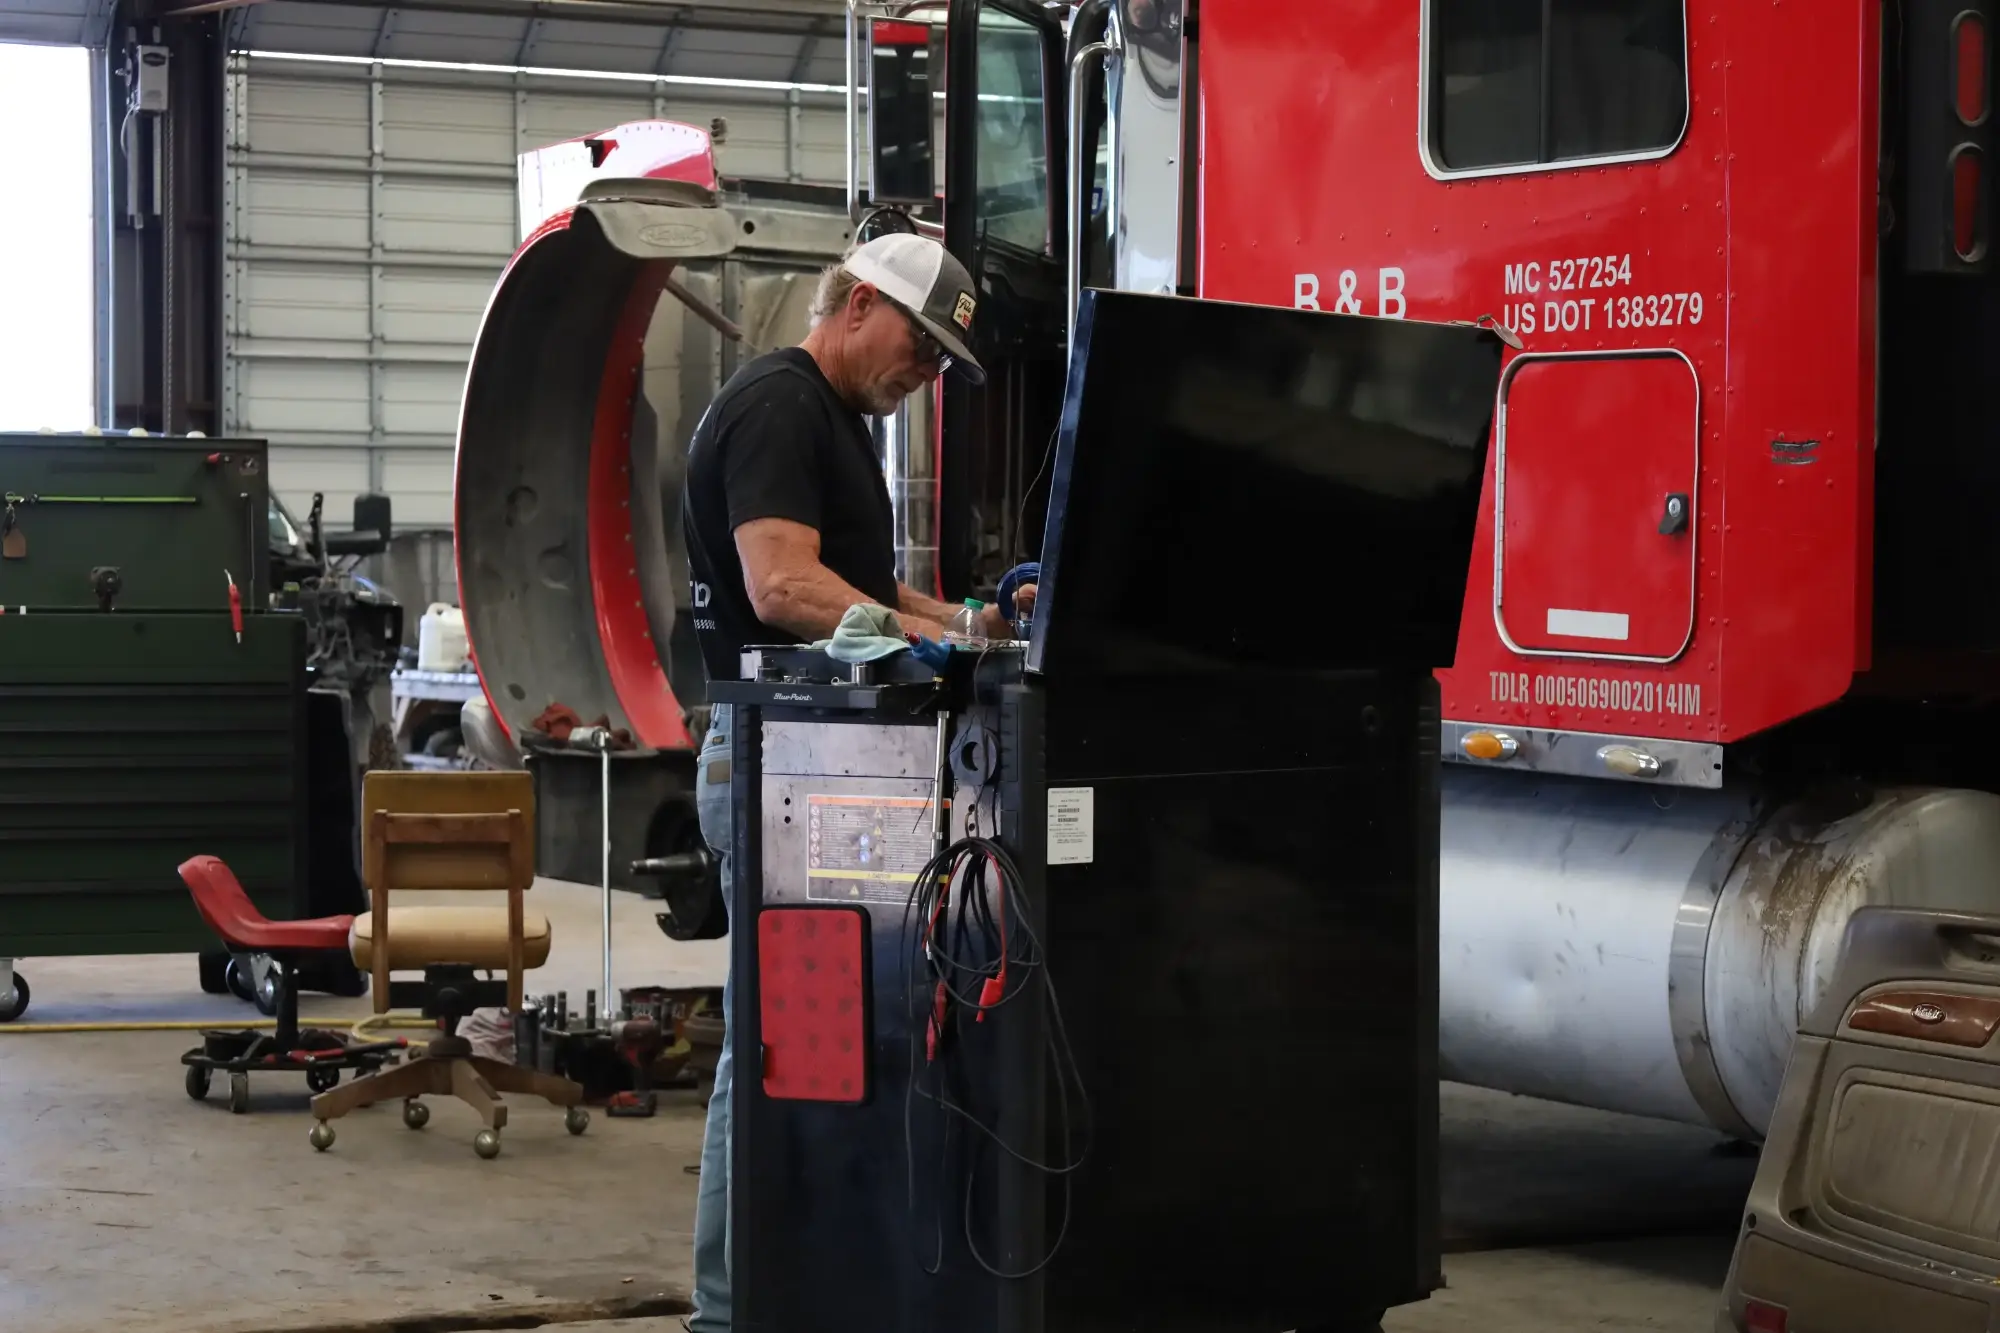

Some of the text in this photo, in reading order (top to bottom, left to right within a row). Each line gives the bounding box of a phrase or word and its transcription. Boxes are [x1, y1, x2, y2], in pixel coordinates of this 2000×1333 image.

[1294, 267, 1407, 320] B & B
[1505, 253, 1632, 295] MC 527254
[1504, 292, 1703, 334] US DOT 1383279
[1489, 671, 1700, 716] TDLR 0005069002014IM
